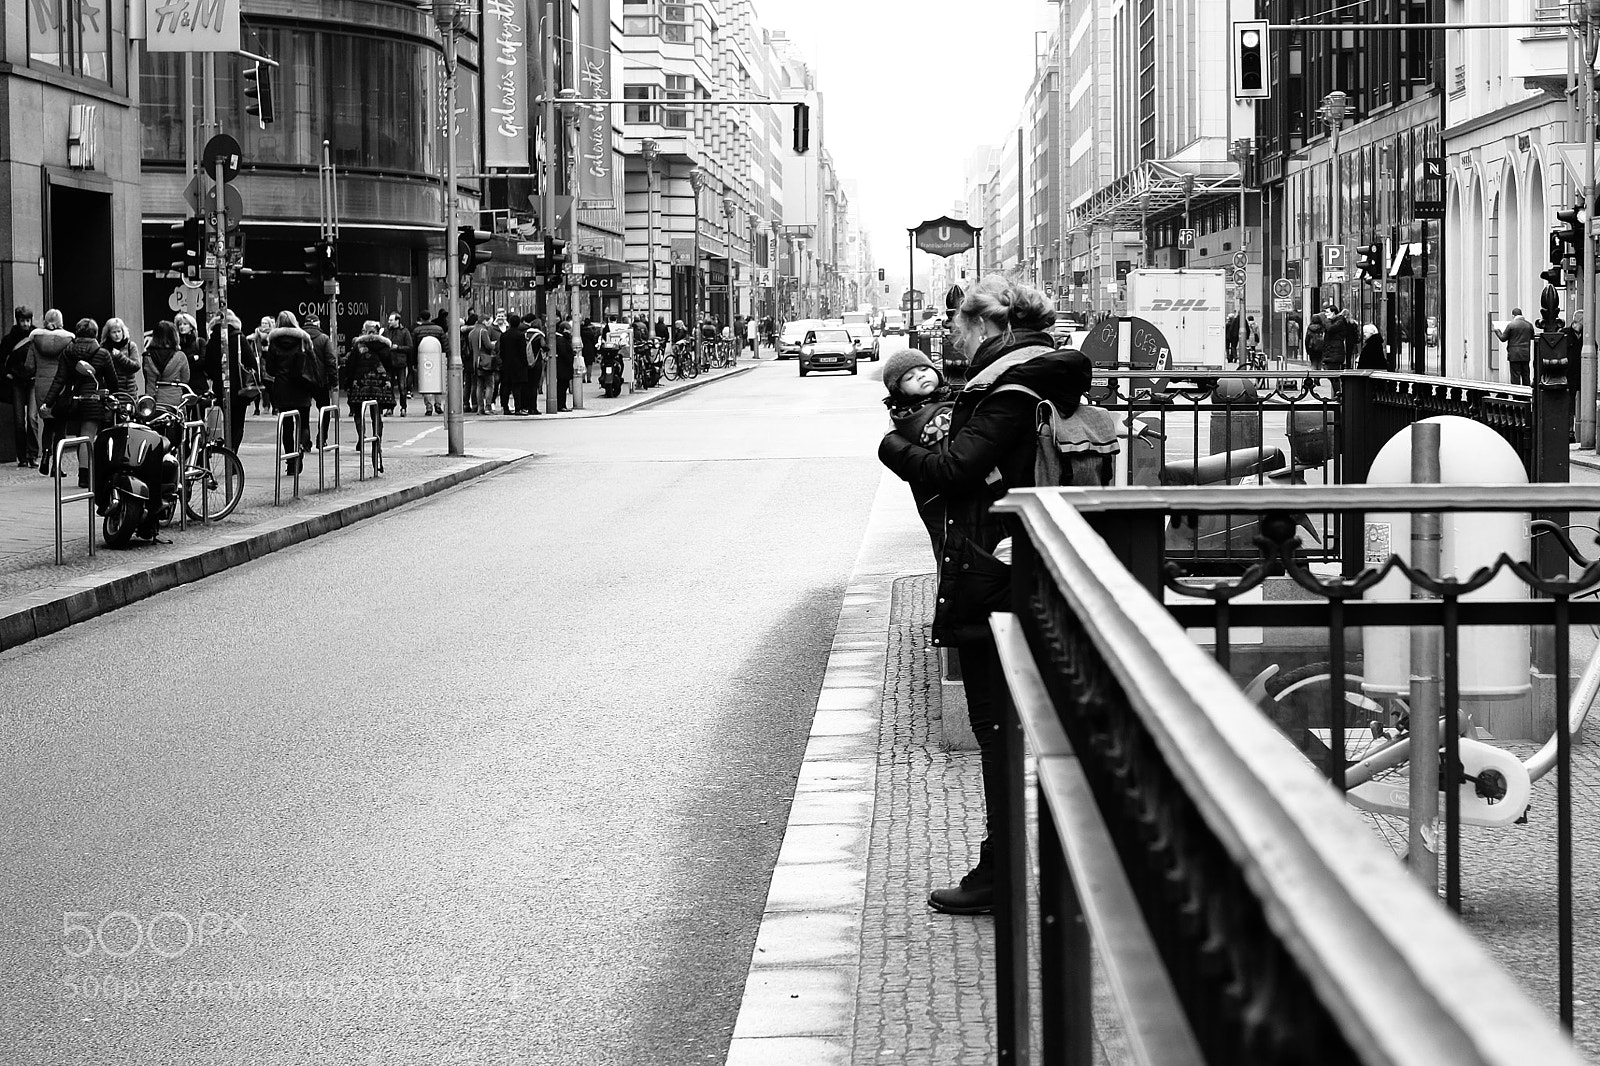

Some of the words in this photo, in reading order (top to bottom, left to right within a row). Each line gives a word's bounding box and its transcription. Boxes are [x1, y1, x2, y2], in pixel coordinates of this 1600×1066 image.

[155, 0, 226, 33] H&M
[490, 70, 524, 137] Galeries
[583, 125, 610, 178] Galeries
[938, 226, 951, 241] U
[1328, 247, 1341, 265] P
[580, 279, 613, 288] UCCI
[298, 302, 344, 316] COMIG
[347, 302, 369, 316] SOON
[1151, 299, 1209, 311] DHL
